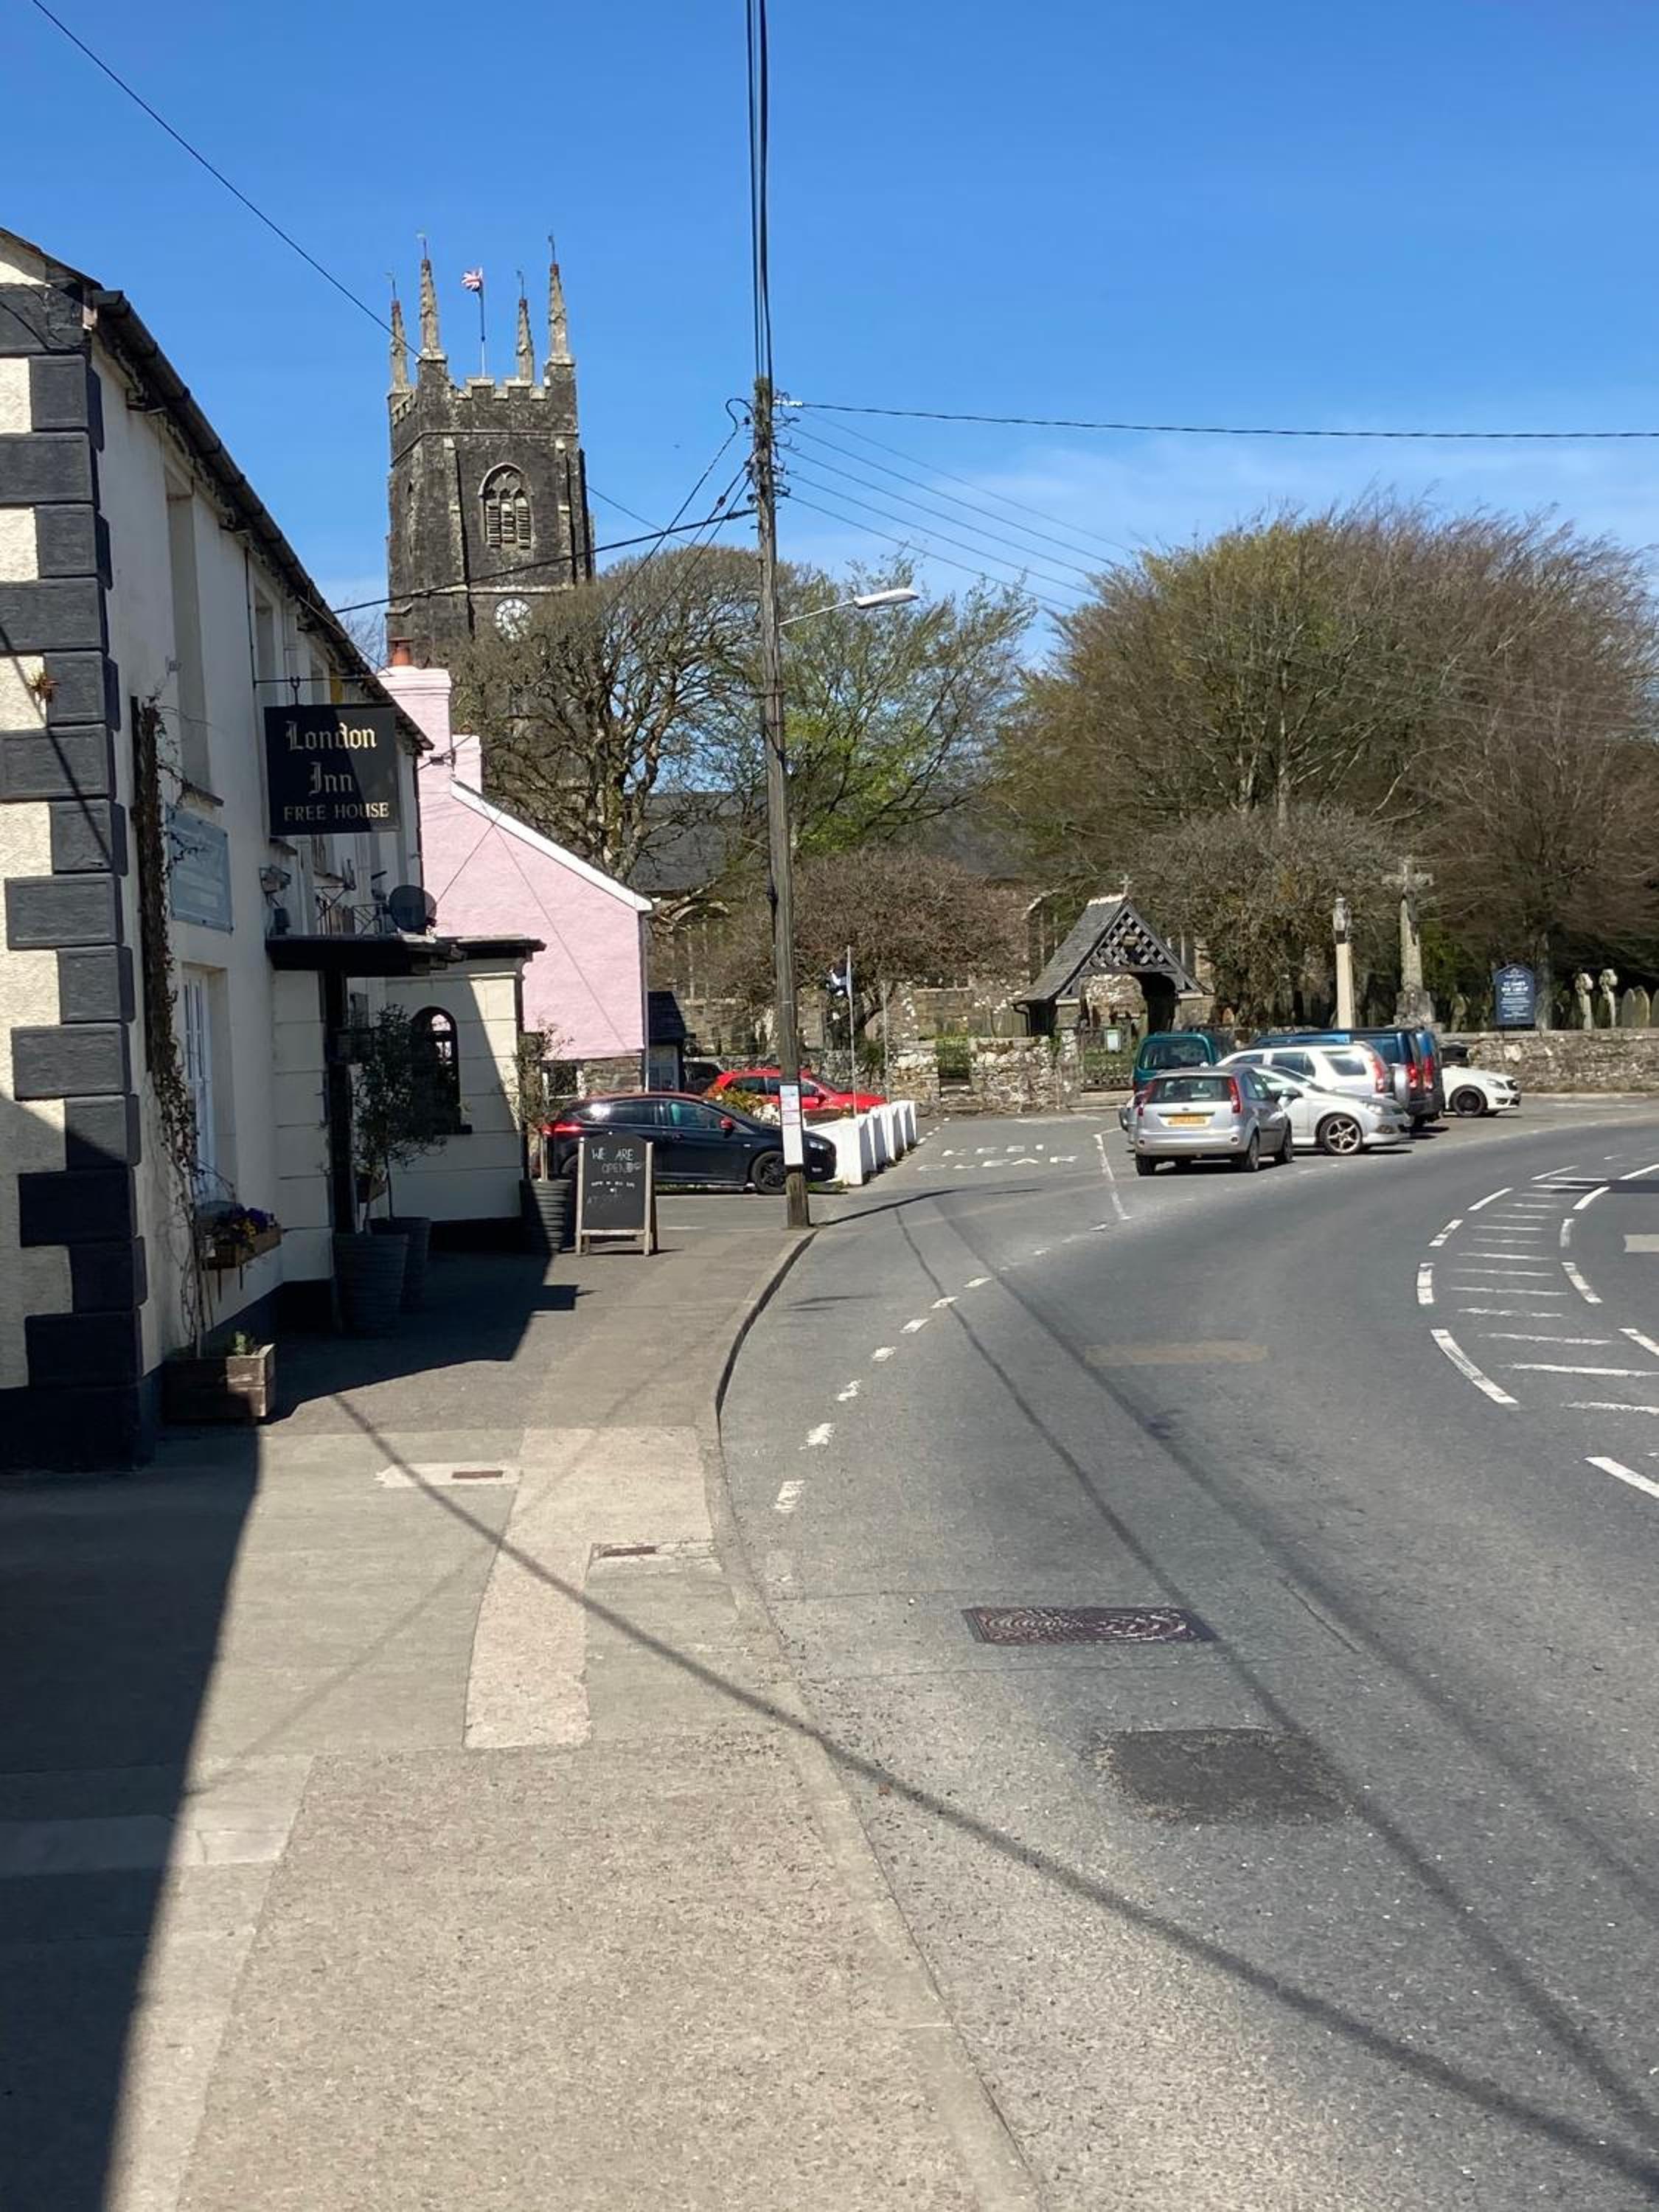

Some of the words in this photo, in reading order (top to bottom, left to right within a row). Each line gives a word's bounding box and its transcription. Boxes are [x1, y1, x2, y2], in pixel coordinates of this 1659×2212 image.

[285, 720, 378, 751] London
[308, 762, 352, 796] Inn
[284, 805, 325, 821] FREE
[335, 802, 389, 818] HOUSE
[592, 1147, 605, 1160] WE
[615, 1148, 634, 1161] ARE
